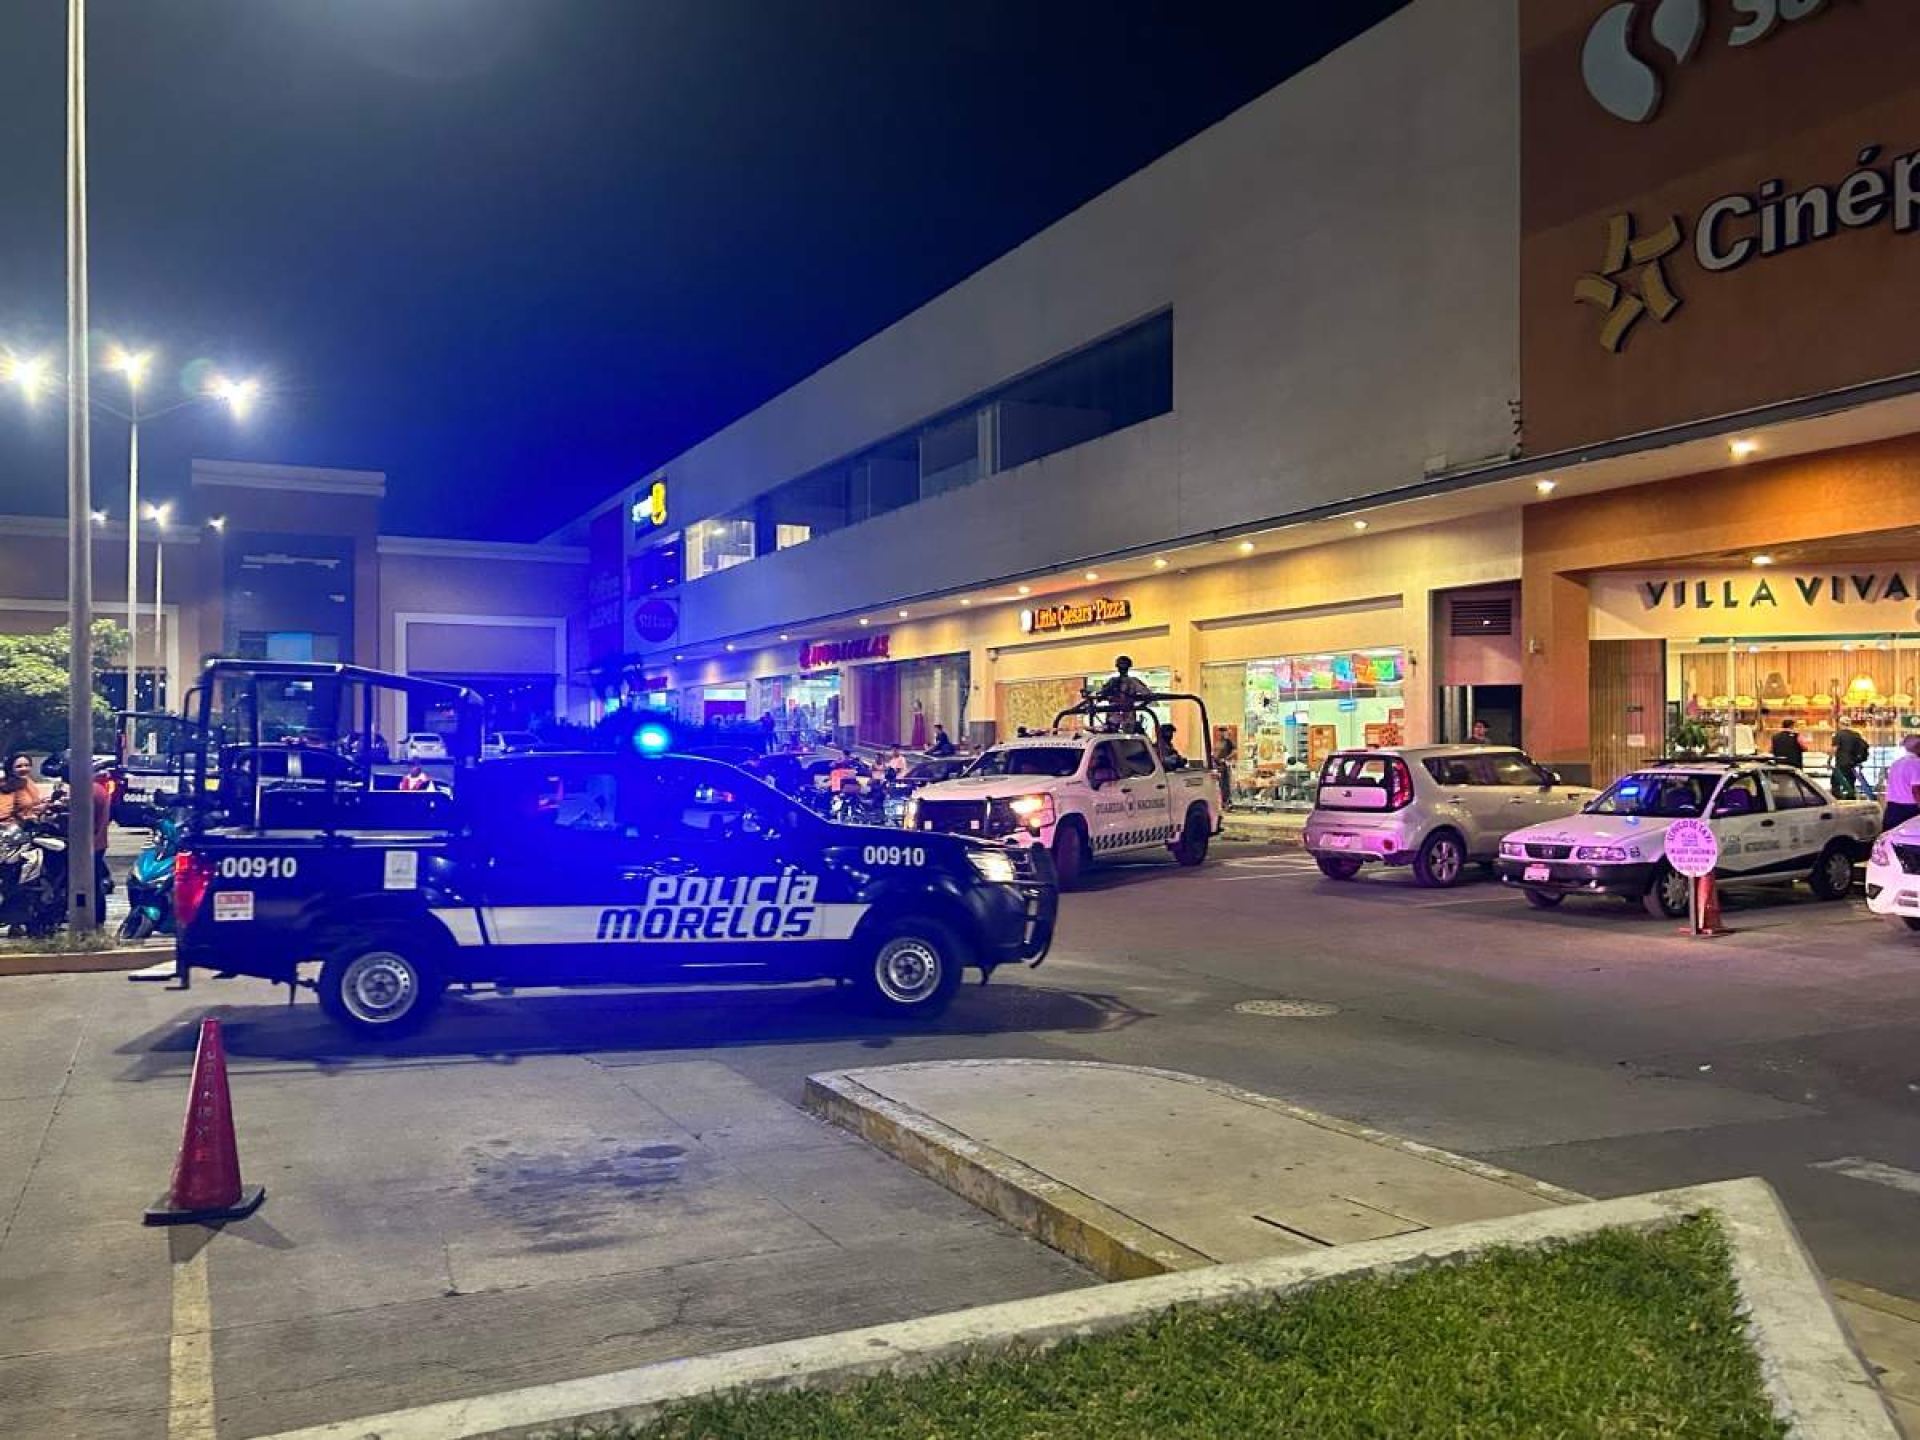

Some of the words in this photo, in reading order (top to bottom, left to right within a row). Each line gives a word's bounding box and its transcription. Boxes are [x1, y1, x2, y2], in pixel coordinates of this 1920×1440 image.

[1643, 577, 1777, 609] VILLA
[1795, 572, 1920, 606] VIVA
[1034, 609, 1058, 630] Little
[1095, 599, 1128, 621] Pizza
[222, 856, 297, 878] 00910
[863, 845, 925, 866] 00910
[596, 905, 817, 940] MORELOS
